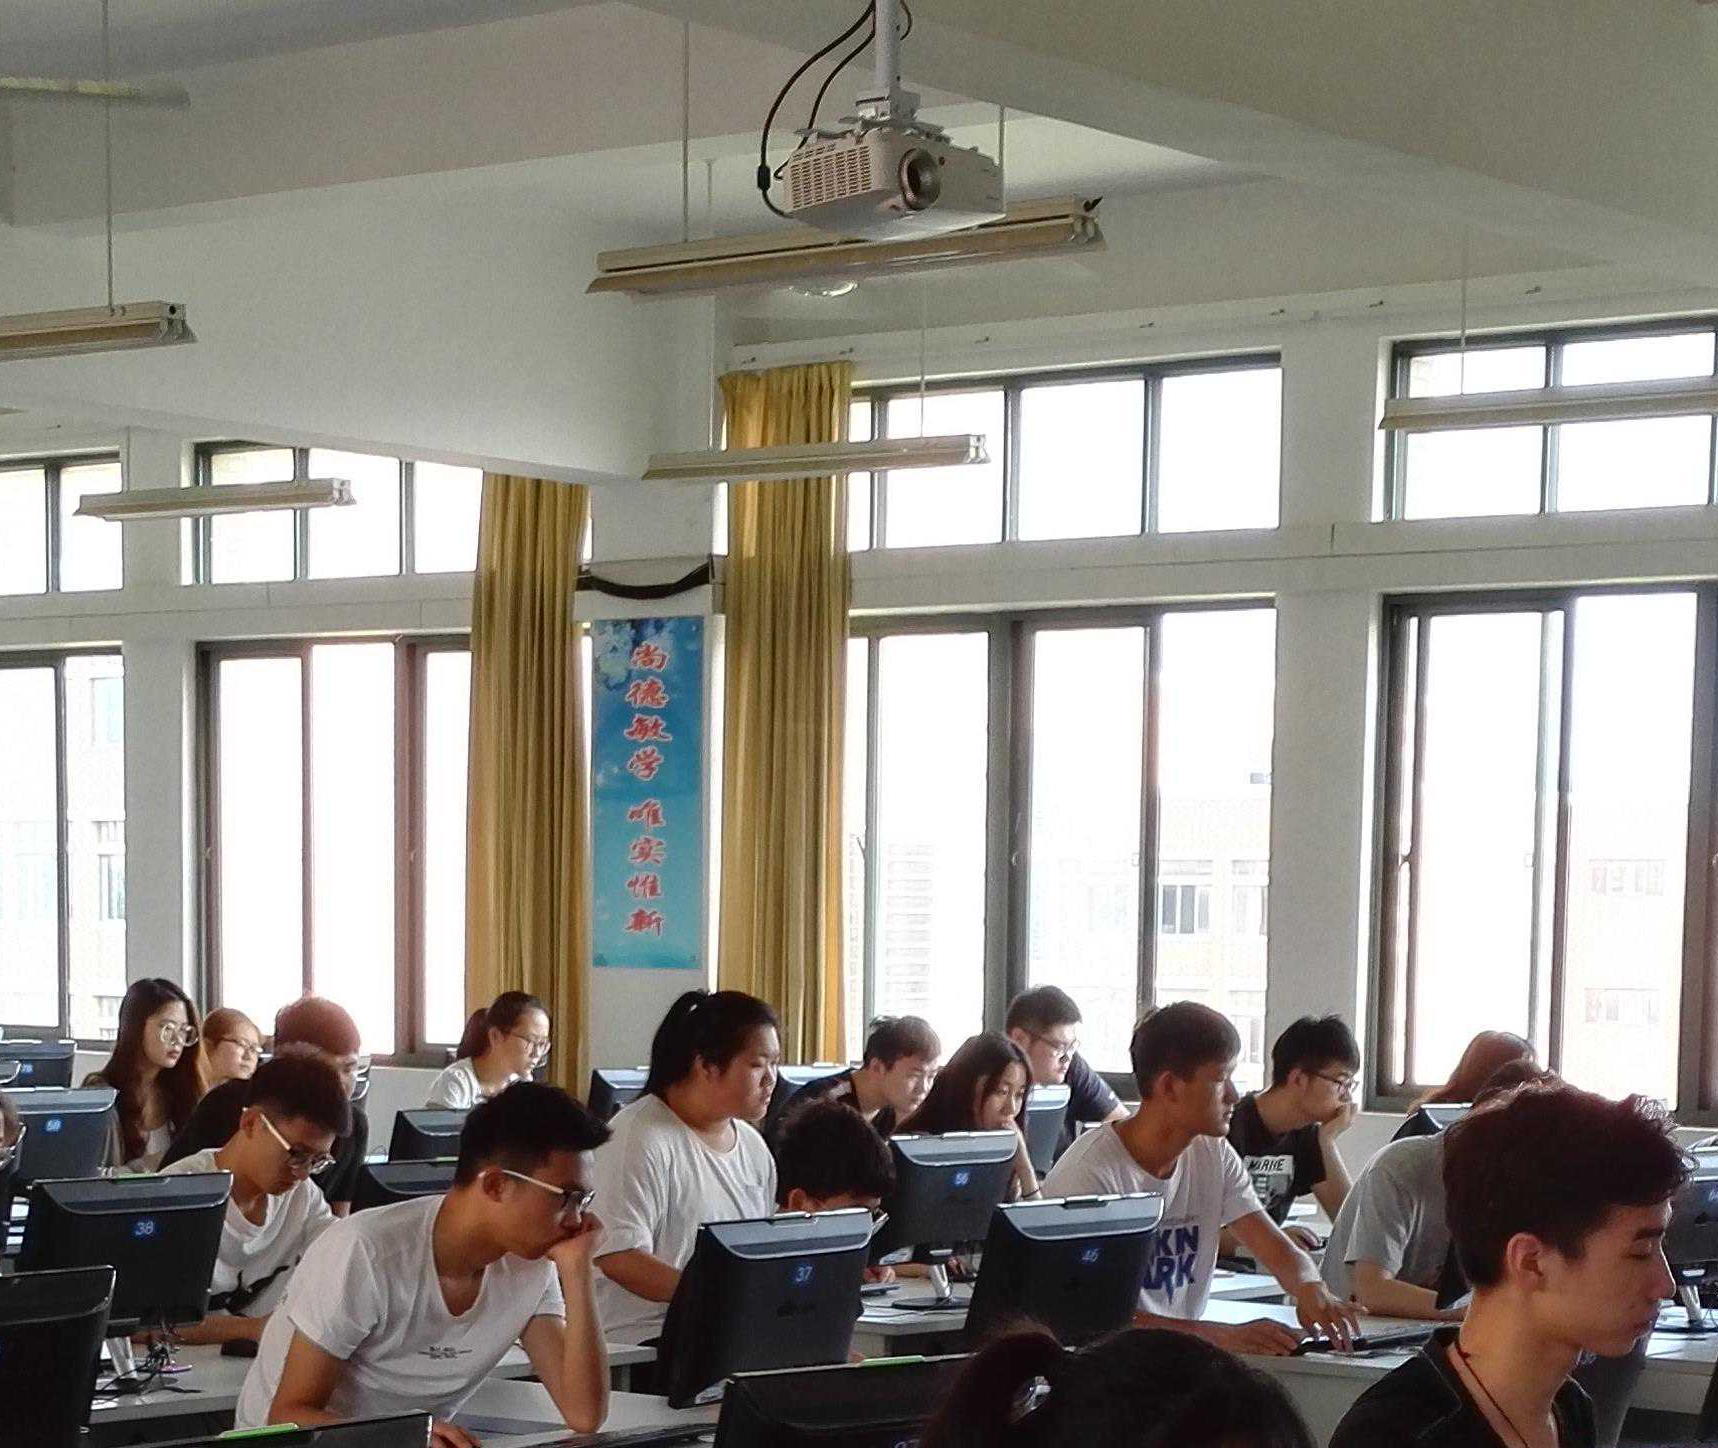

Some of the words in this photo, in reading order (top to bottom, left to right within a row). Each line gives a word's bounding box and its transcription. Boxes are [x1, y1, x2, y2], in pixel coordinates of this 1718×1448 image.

[623, 642, 673, 781] 尚德敏学
[135, 1220, 155, 1237] 38
[794, 1265, 814, 1284] 37
